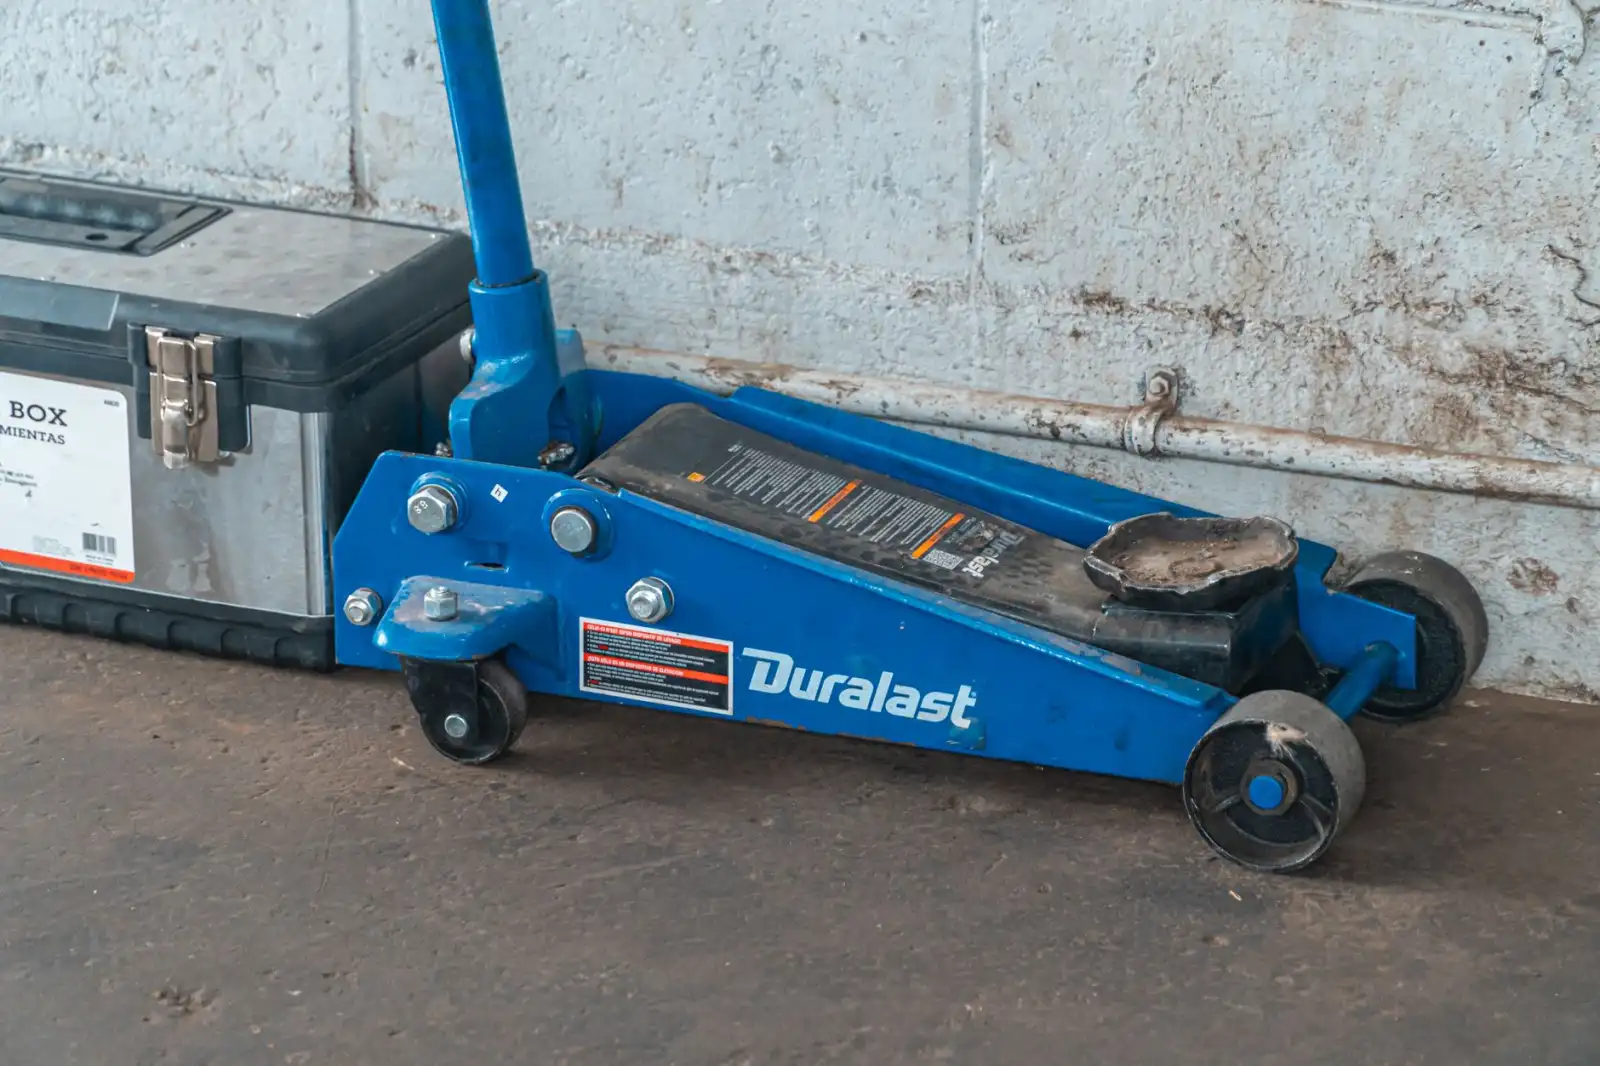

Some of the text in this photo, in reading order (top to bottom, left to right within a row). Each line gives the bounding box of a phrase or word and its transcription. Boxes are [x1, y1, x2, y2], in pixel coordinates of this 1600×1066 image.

[9, 400, 68, 427] BOX
[0, 424, 66, 445] MIENTAS
[742, 647, 977, 729] Duralast
